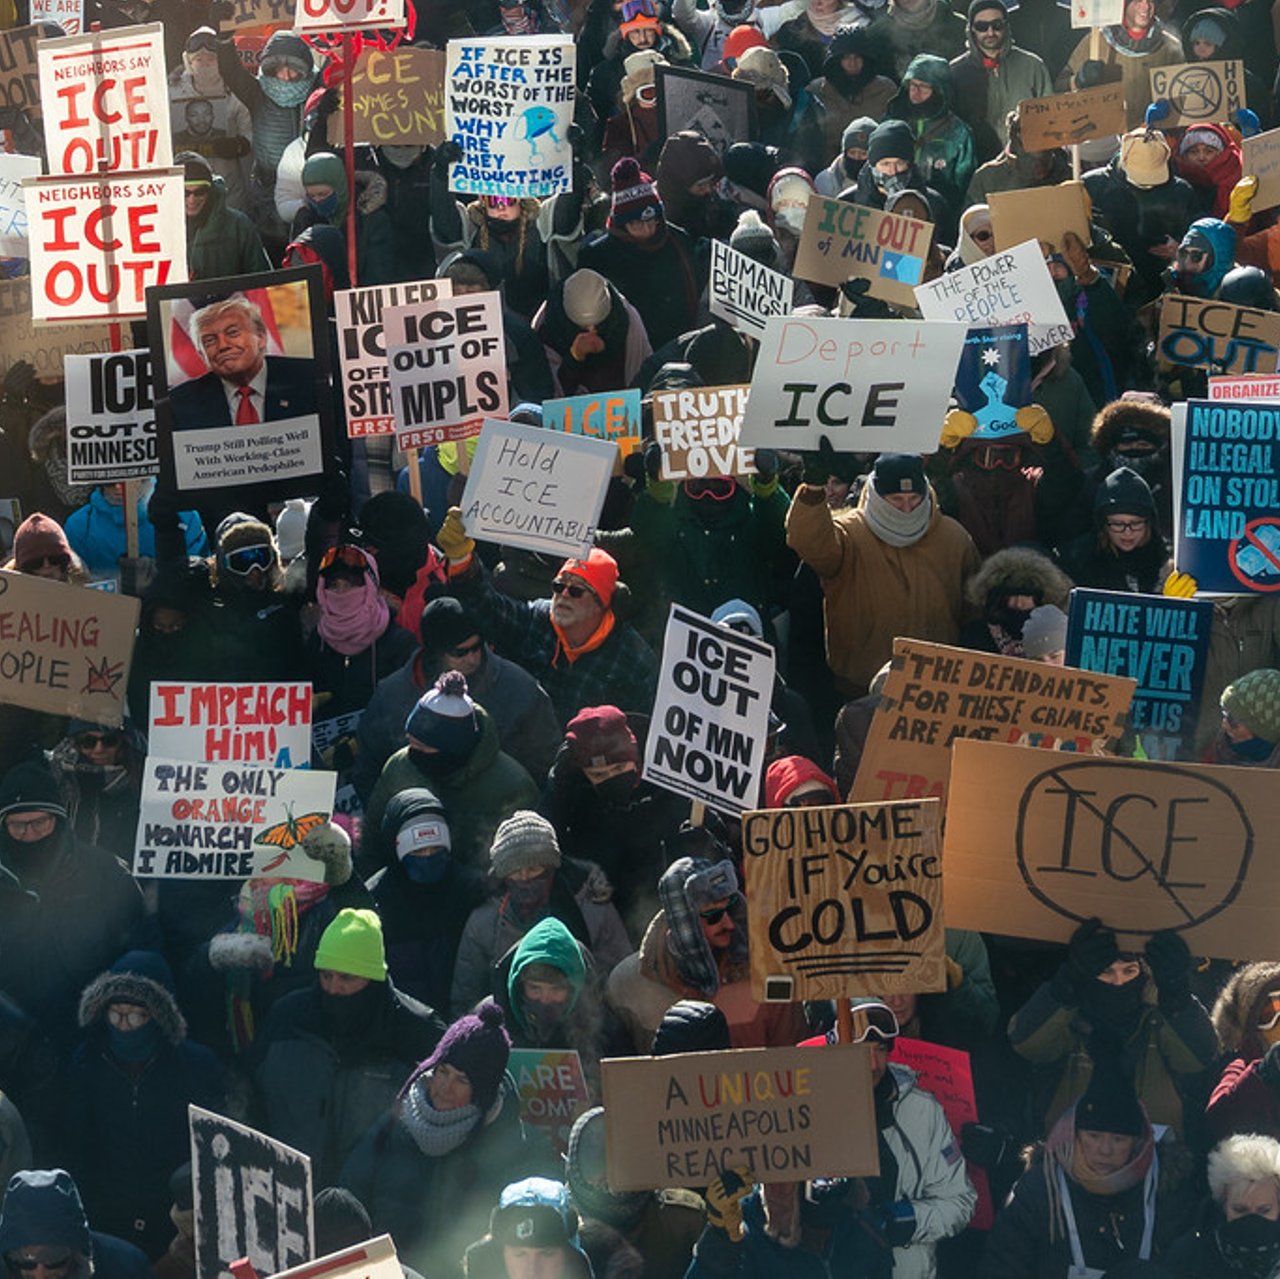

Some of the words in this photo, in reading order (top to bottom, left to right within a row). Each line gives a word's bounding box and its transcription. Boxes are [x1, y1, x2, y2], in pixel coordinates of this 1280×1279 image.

[460, 47, 485, 63] IF
[494, 47, 533, 64] ICE
[539, 48, 562, 64] IS
[452, 63, 525, 83] AFTER
[534, 66, 573, 83] THE
[452, 80, 519, 101] WORST
[523, 85, 543, 100] OF
[547, 85, 575, 102] THE
[455, 117, 505, 139] WHY
[39, 185, 130, 204] NEIGHBORS
[135, 183, 166, 198] SAY
[43, 203, 160, 253] ICE
[45, 257, 170, 306] OUT!
[404, 305, 487, 340] ICE
[394, 345, 454, 371] OUT
[462, 337, 499, 363] OF
[776, 324, 926, 376] Deport
[402, 374, 500, 425] MPLS
[775, 382, 905, 427] ICE
[1211, 382, 1280, 399] ORGANIZE
[184, 443, 221, 454] Trump
[223, 439, 245, 449] Still
[247, 434, 284, 447] Polling
[286, 430, 309, 440] Well
[195, 456, 221, 466] With
[224, 447, 301, 463] Working-Class
[500, 437, 557, 475] Hold
[1190, 441, 1274, 474] ILLEGAL
[193, 467, 246, 480] American
[248, 459, 305, 473] Pedophiles
[498, 482, 558, 512] ICE
[1187, 475, 1221, 503] ON
[467, 505, 596, 543] ACCOUNTABLE
[1186, 507, 1245, 539] LAND
[687, 629, 752, 683] ICE
[155, 685, 311, 726] IMPEACH
[672, 665, 759, 719] OUT
[664, 705, 704, 740] OF
[707, 722, 755, 765] MN
[155, 765, 208, 791] THE
[222, 771, 283, 795] ONLY
[654, 742, 751, 800] NOW
[172, 798, 268, 821] ORANGE
[145, 824, 253, 849] MONARCH
[1036, 787, 1209, 888] ICE
[138, 851, 154, 874] I
[164, 852, 254, 875] ADMIRE
[788, 853, 827, 898] IF
[769, 892, 932, 953] COLD
[666, 1078, 687, 1109] A
[700, 1068, 811, 1108] UNIQUE
[659, 1106, 811, 1144] MINNEAPOLIS
[667, 1145, 811, 1177] REACTION
